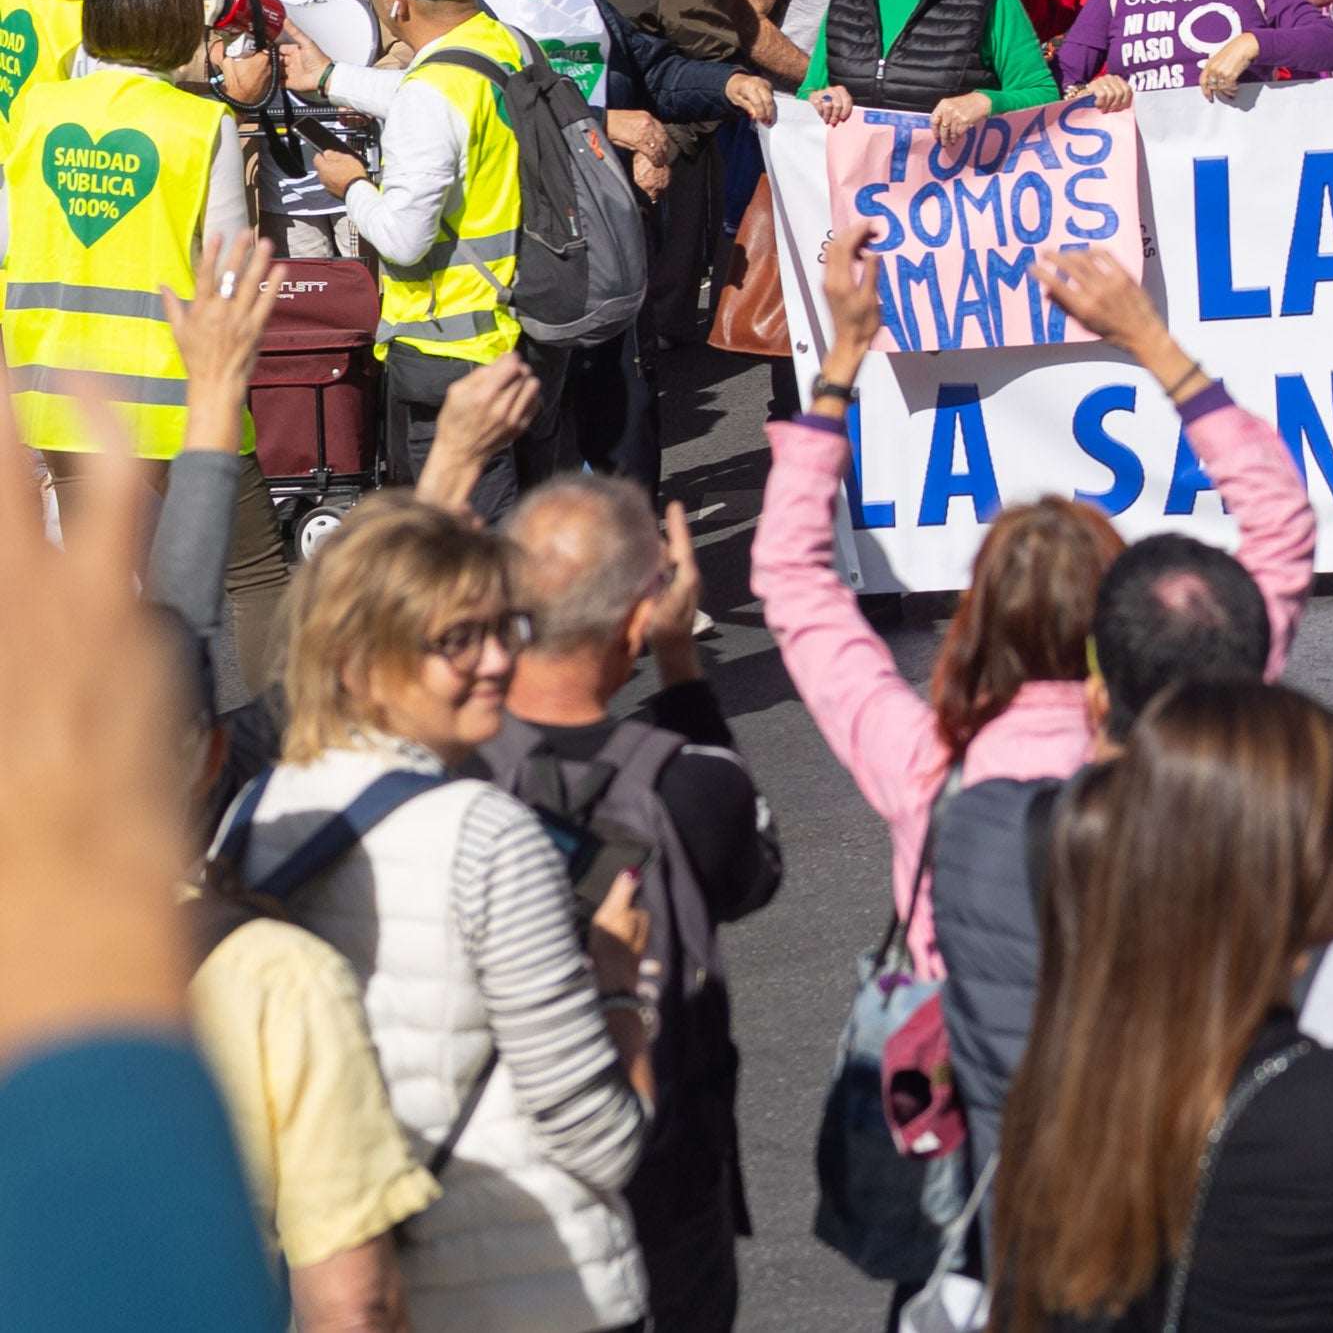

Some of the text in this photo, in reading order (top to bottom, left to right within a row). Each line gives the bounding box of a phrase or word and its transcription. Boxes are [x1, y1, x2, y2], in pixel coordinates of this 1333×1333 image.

[1123, 10, 1176, 37] NI UN
[1121, 36, 1174, 67] PASO
[863, 94, 1113, 183] TODAS
[54, 147, 140, 173] SANIDAD
[57, 168, 136, 197] PÚBLICA
[68, 197, 120, 219] 100%
[855, 167, 1120, 253] SOMOS
[846, 380, 1003, 530] LA
